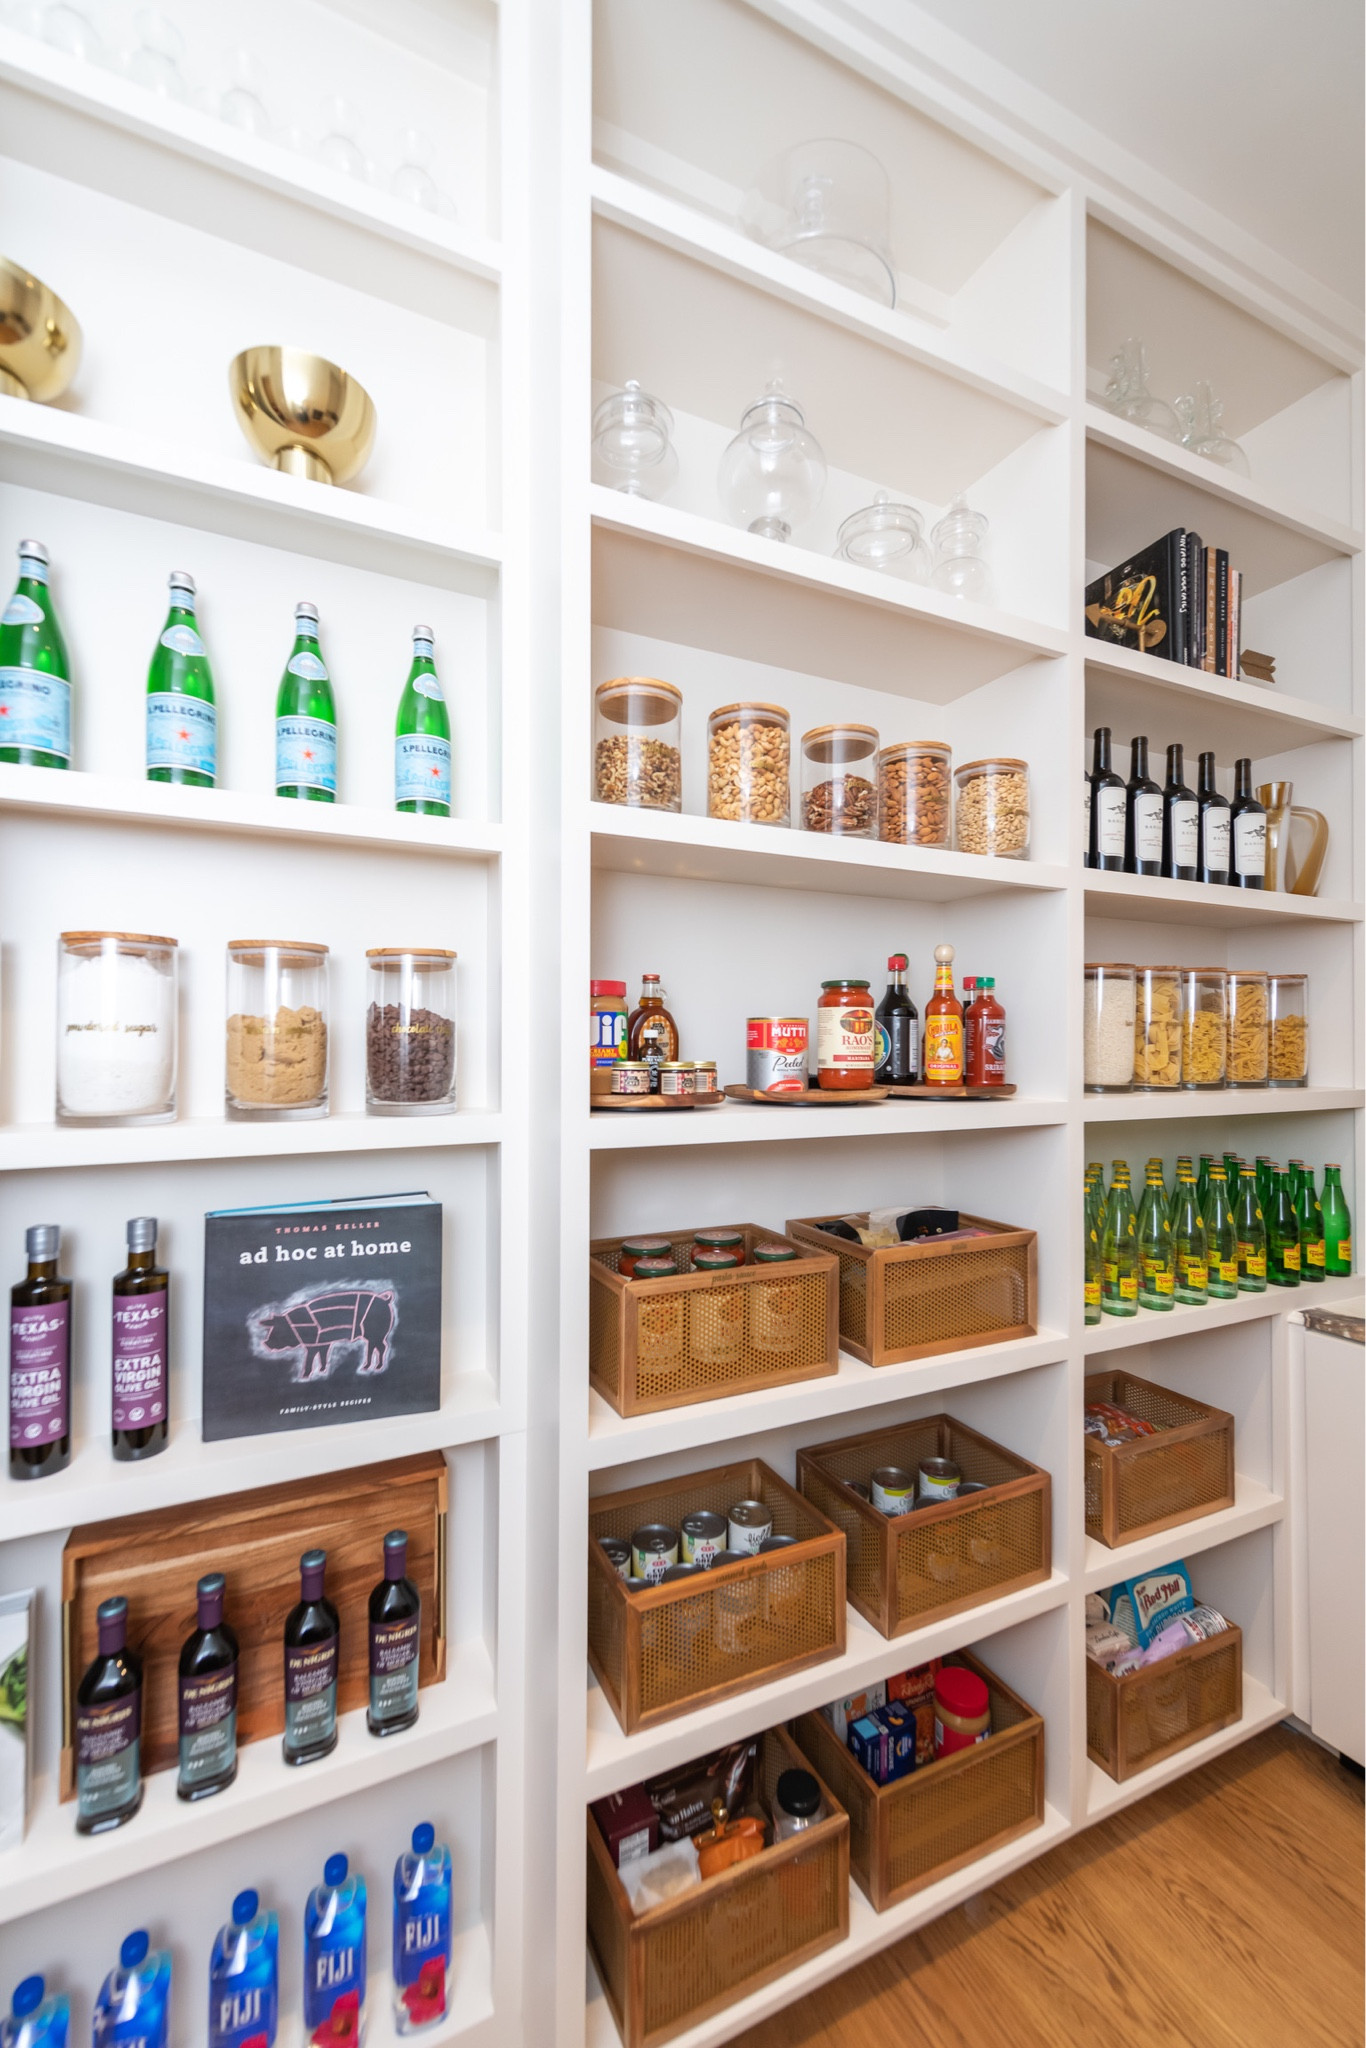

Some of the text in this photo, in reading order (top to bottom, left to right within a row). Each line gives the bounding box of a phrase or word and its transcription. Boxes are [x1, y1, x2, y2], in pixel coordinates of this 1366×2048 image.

[391, 1024, 433, 1034] chocolate
[772, 1027, 806, 1037] MUTTI
[772, 1055, 804, 1072] Peeled
[275, 1221, 380, 1234] THOMAS KELLER
[239, 1240, 412, 1265] ad hoc at home
[115, 1307, 160, 1323] TEXAS
[114, 1354, 161, 1371] EXTRA
[114, 1365, 161, 1384] VIRGIN
[144, 1378, 161, 1390] OIL
[280, 1397, 372, 1415] FAMILY-STYLE RECIPES
[1142, 1589, 1161, 1611] Red
[1161, 1578, 1180, 1603] Mill
[680, 1800, 704, 1820] Halves
[405, 1913, 440, 1952] FIJI
[316, 1947, 353, 1989] FIJI
[219, 1988, 261, 2032] FIJI
